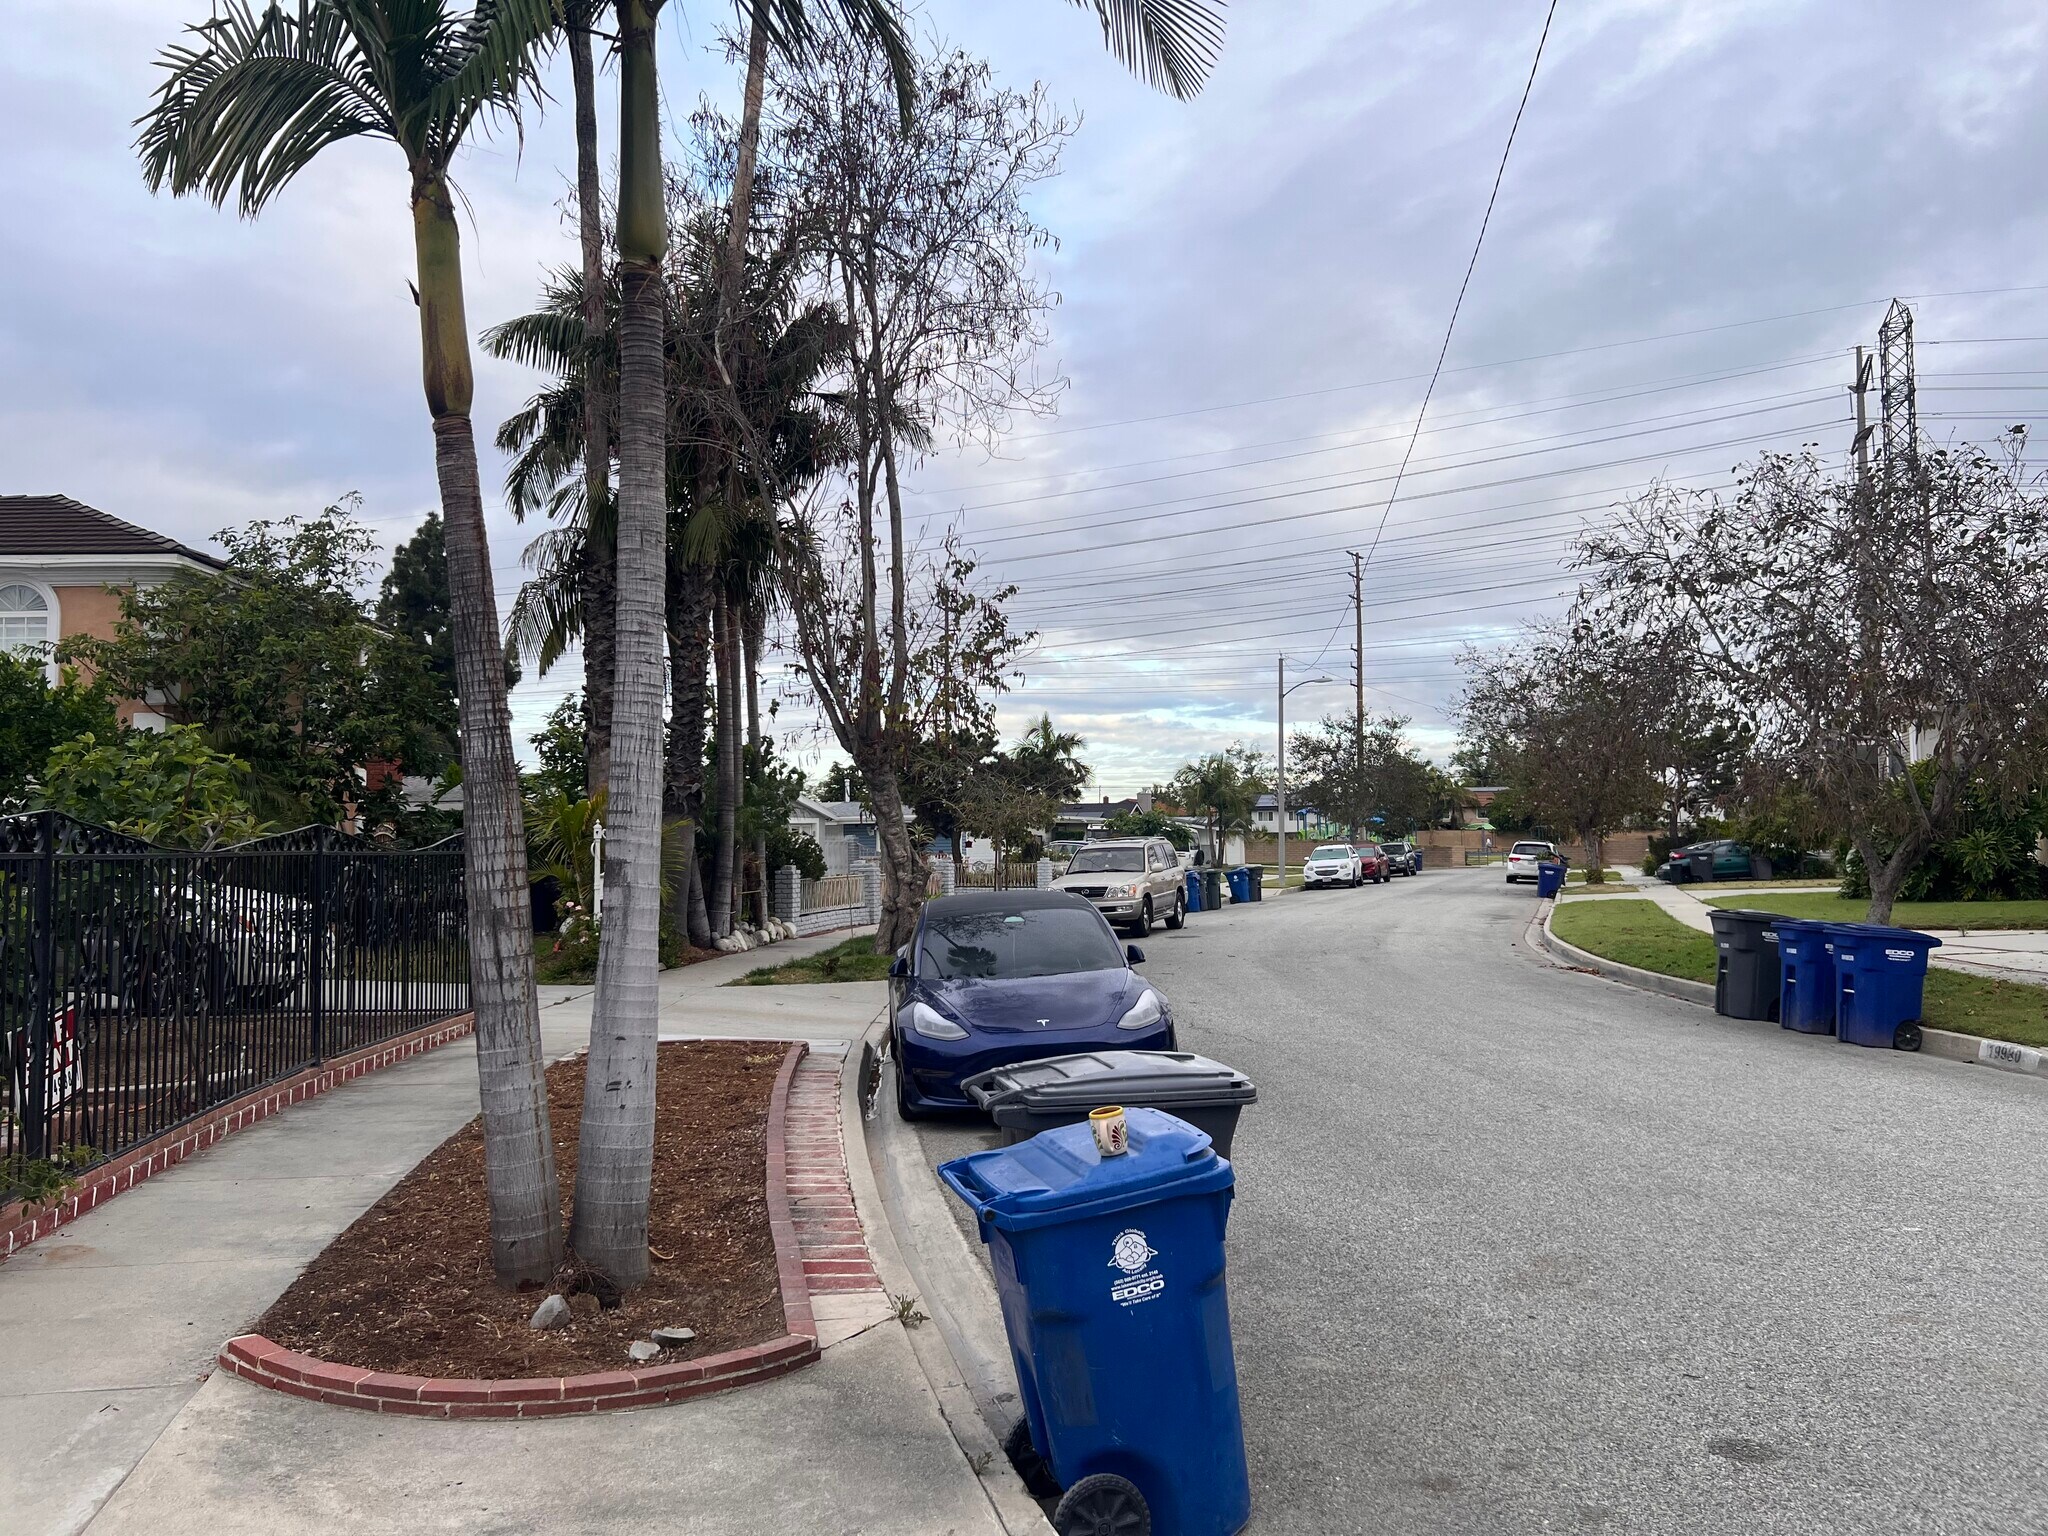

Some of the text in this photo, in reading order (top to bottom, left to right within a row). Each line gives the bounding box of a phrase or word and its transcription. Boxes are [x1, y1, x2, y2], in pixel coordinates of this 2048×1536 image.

[1885, 949, 1914, 957] EDCO
[1111, 1228, 1147, 1246] Think Globally
[1111, 1279, 1165, 1301] EDCO
